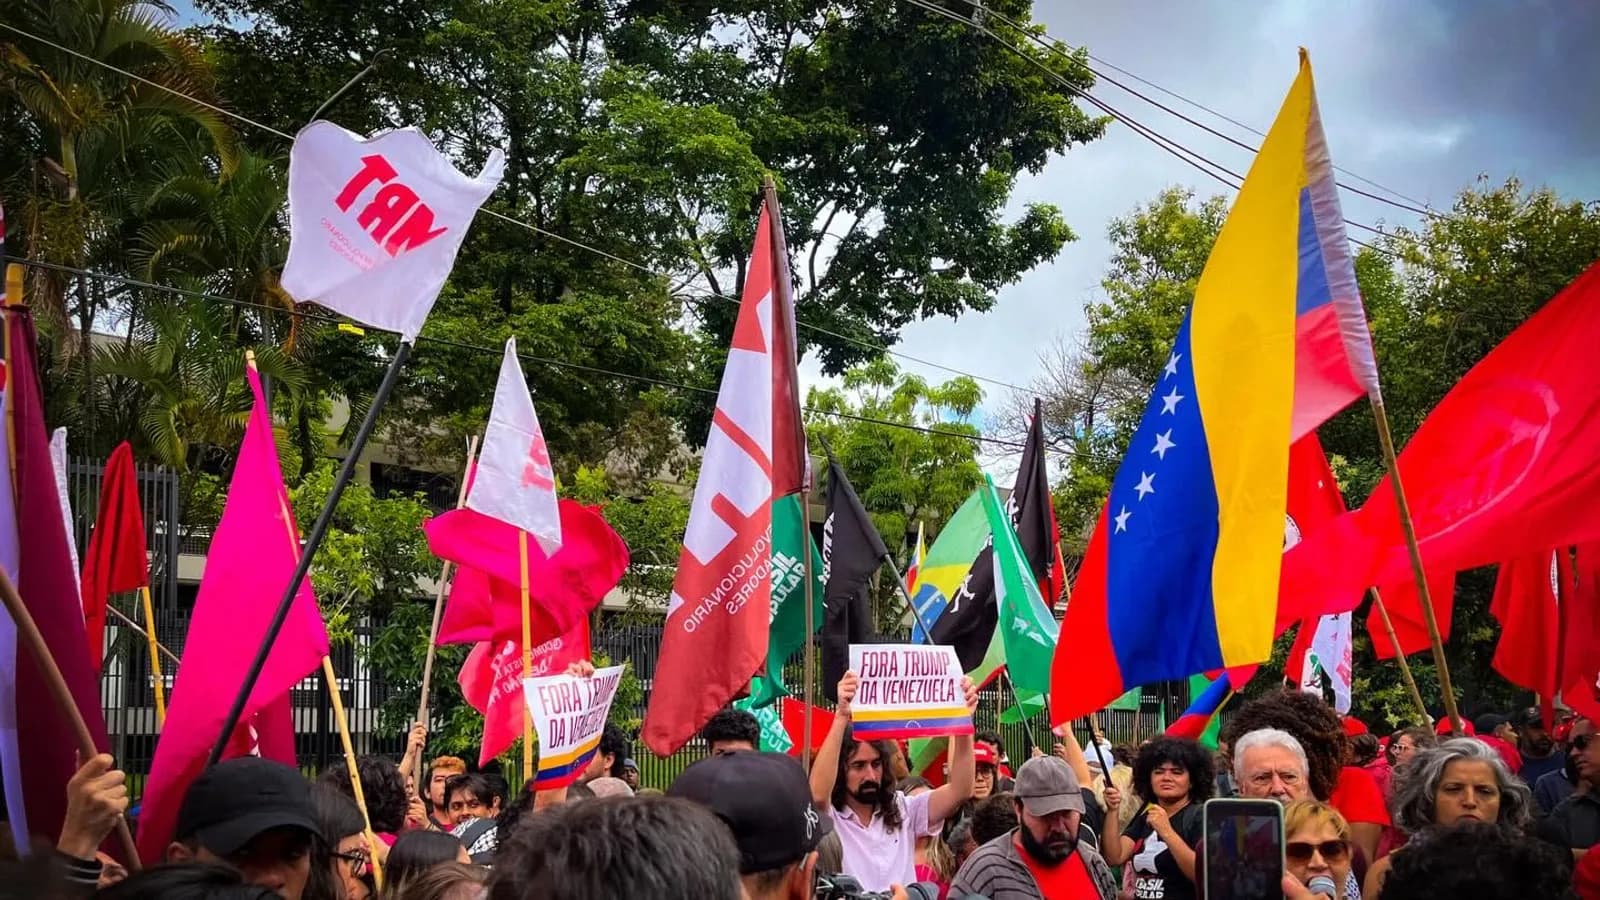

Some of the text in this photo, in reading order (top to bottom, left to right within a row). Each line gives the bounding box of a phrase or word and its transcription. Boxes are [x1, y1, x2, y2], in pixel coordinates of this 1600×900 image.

[860, 650, 951, 678] FORA TRUMP
[537, 680, 582, 716] FORA
[859, 678, 956, 705] DA VENEZUELA
[548, 717, 566, 749] DA
